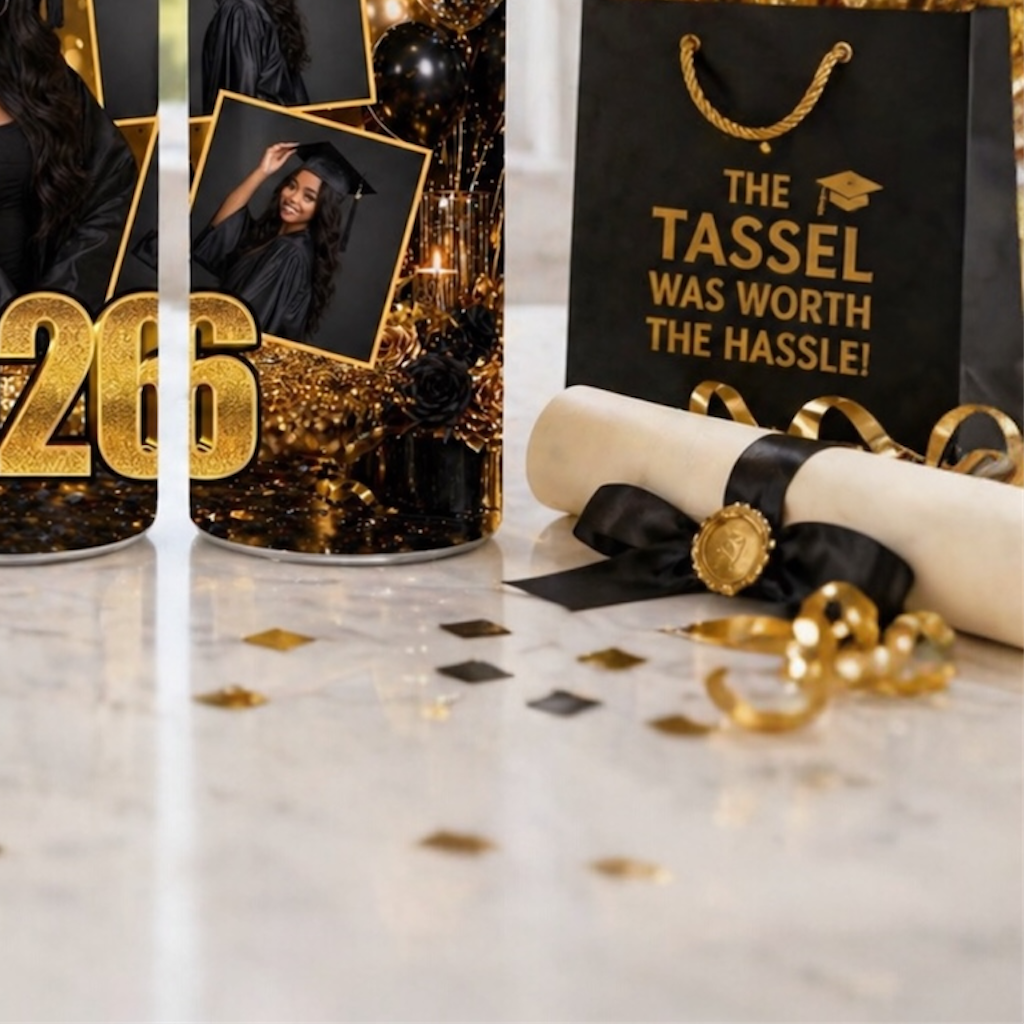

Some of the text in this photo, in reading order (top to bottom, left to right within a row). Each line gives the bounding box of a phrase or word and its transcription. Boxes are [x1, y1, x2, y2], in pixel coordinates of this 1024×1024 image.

[724, 169, 791, 209] THE
[652, 206, 873, 283] TASSEL
[648, 270, 872, 330] WAS WORTH
[646, 316, 871, 377] THE HASSLE!
